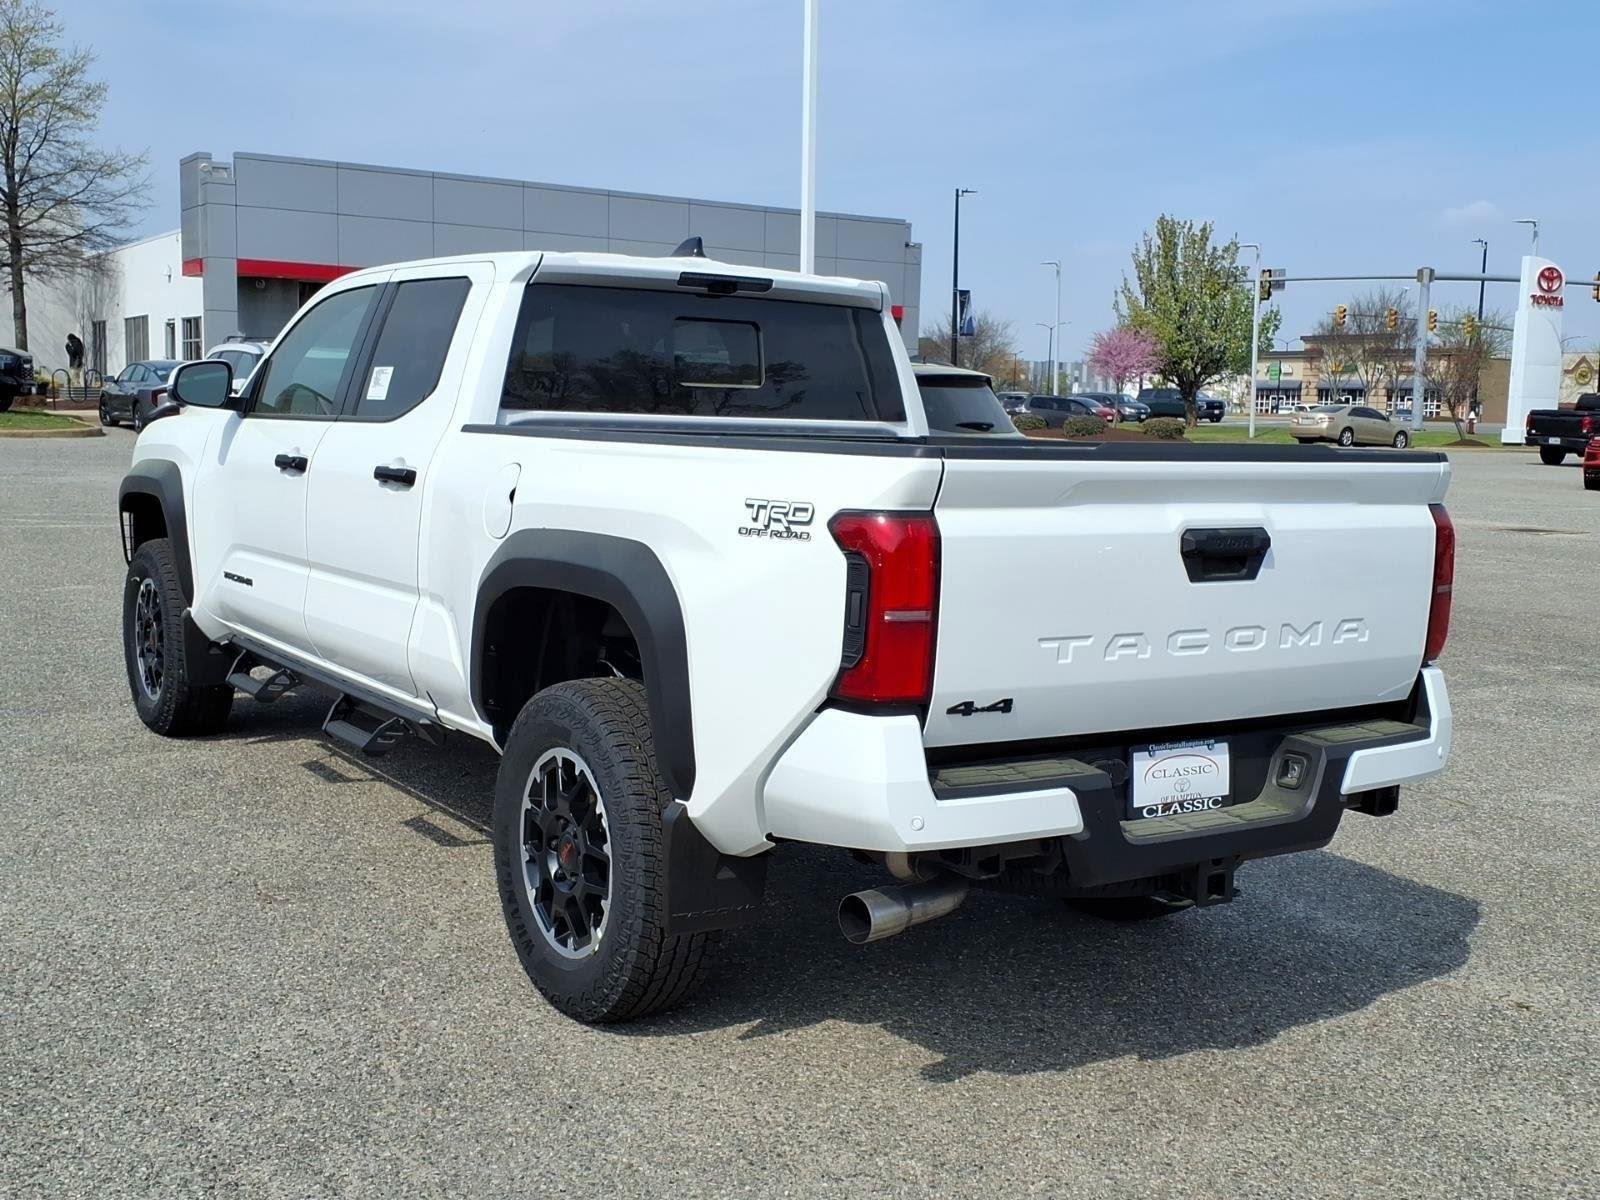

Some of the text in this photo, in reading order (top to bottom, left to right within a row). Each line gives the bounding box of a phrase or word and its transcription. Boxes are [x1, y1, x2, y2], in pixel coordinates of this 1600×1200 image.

[1530, 294, 1564, 307] TOYOTA
[745, 498, 815, 531] TRD
[738, 527, 812, 541] OFF ROAD
[1038, 618, 1369, 664] TACOMA
[1152, 764, 1213, 779] CLASSIC
[1143, 797, 1222, 818] CLASSIC
